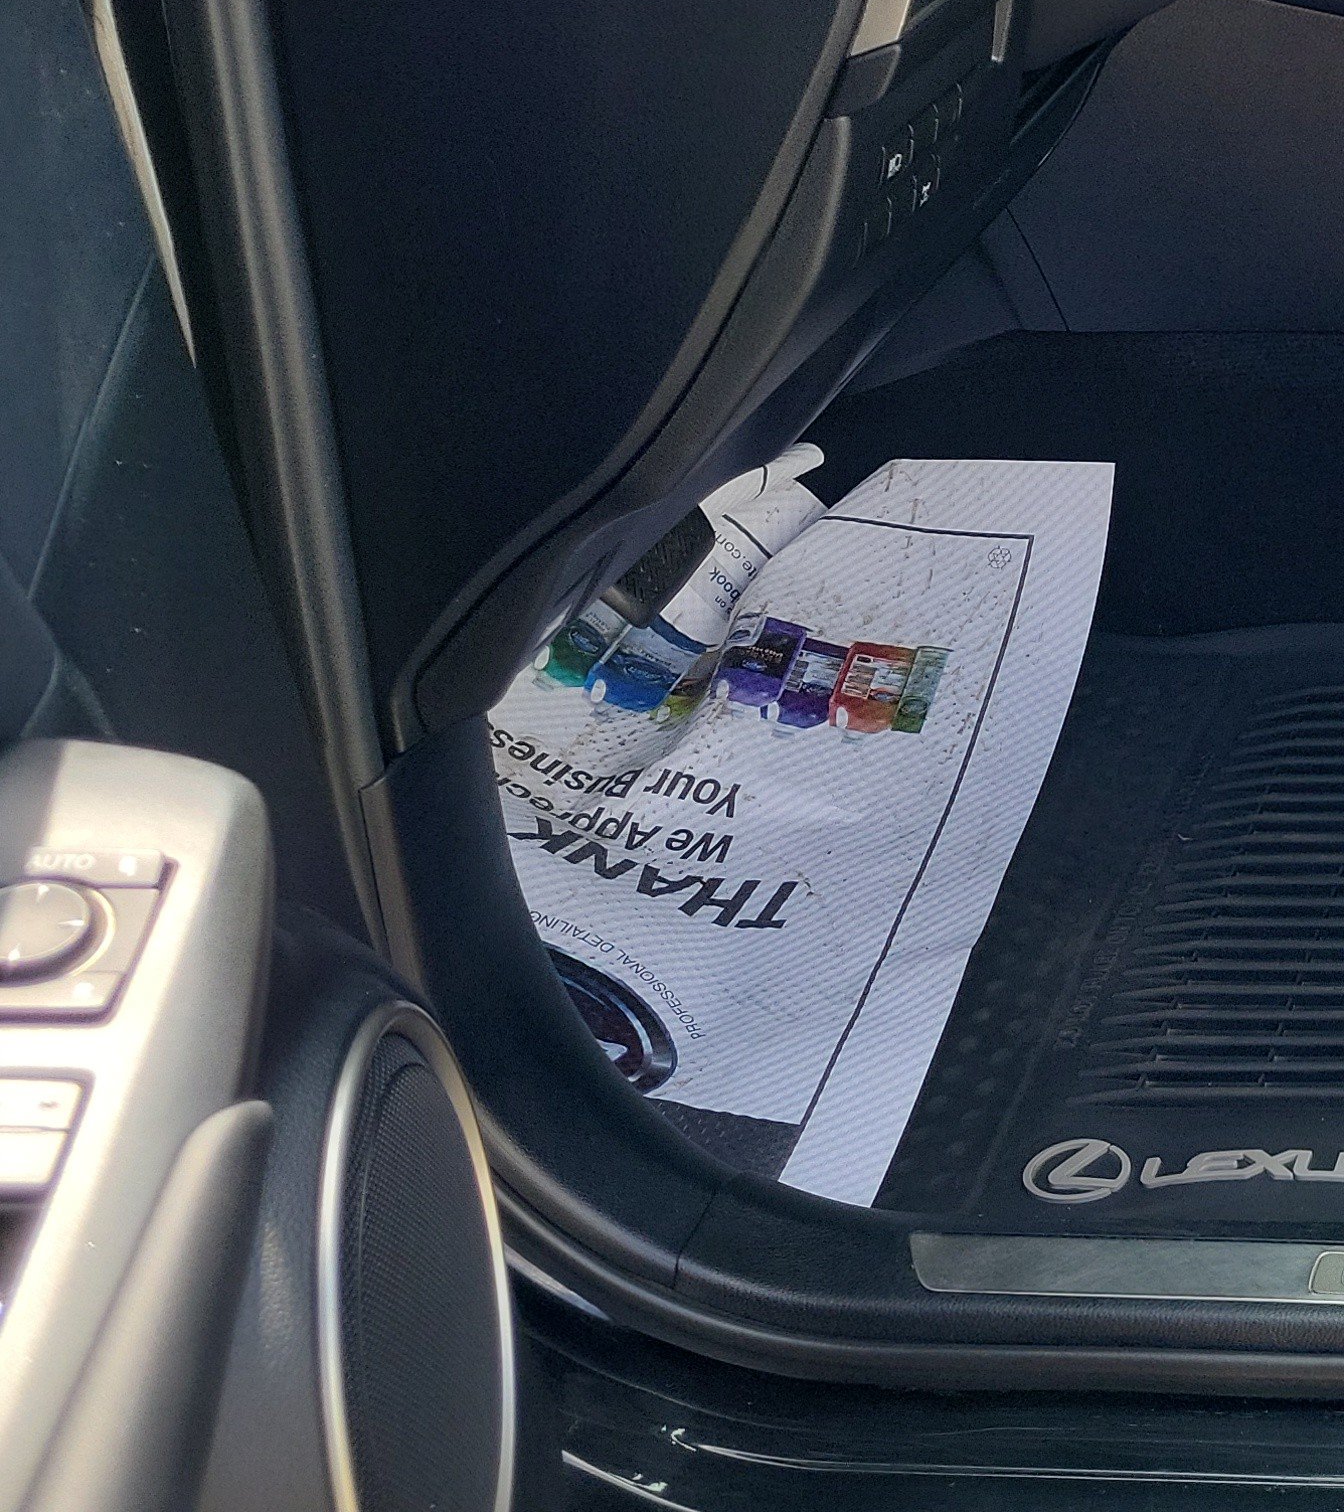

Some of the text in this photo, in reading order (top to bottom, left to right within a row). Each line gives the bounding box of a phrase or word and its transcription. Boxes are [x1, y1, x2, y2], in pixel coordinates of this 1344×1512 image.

[487, 721, 742, 819] Your Busines
[506, 815, 800, 930] THANK
[664, 827, 735, 864] We
[616, 950, 707, 1040] PROFESSIONAL
